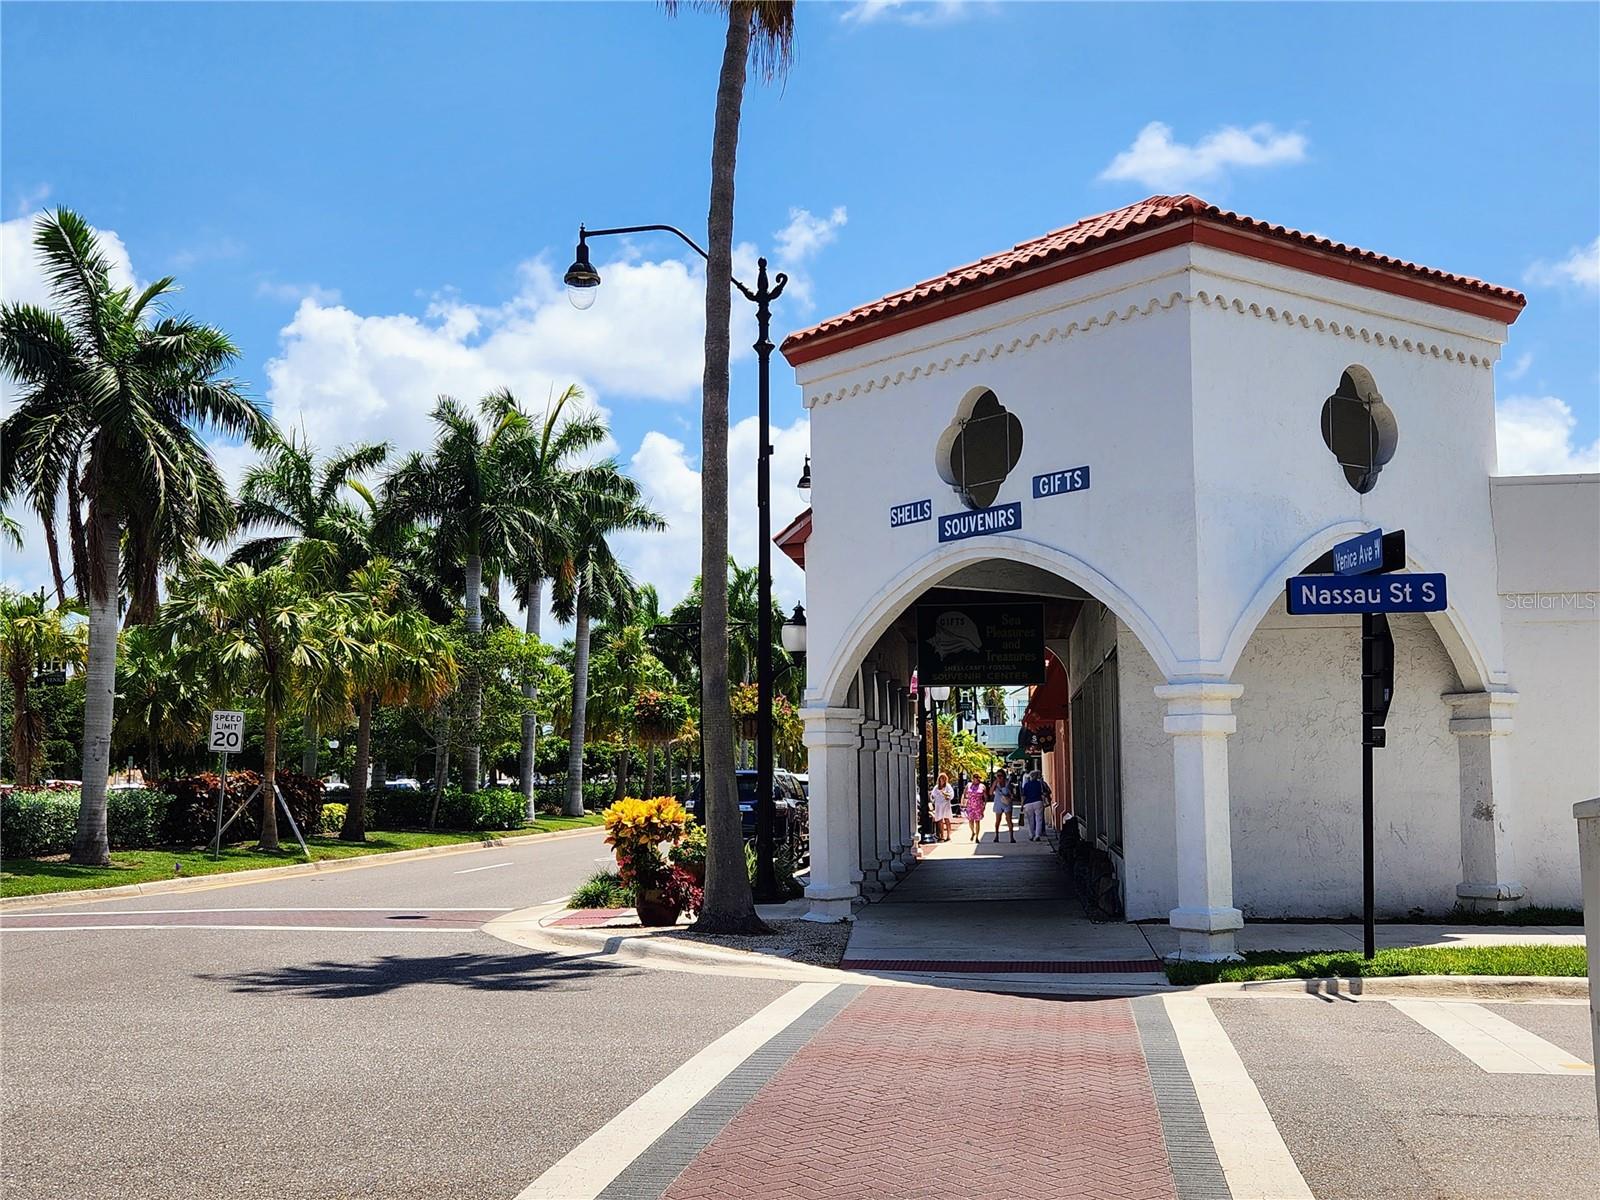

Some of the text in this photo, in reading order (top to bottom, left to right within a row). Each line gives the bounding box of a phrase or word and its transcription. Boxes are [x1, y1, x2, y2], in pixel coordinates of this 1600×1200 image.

[1039, 470, 1082, 495] GIFTS
[891, 502, 931, 525] SHELLS
[944, 508, 1015, 537] SOUVENIRS
[1335, 548, 1357, 572] Venice
[1358, 544, 1373, 565] Ave
[1301, 582, 1436, 605] Nassau St S
[940, 616, 966, 626] GIFTS
[1001, 614, 1021, 625] Sea
[1002, 639, 1021, 649] and
[985, 649, 1037, 662] Treasures
[932, 671, 1030, 681] SOUVENIR CENTER
[214, 713, 242, 723] SPEED
[216, 723, 238, 731] LIMIT
[213, 732, 240, 747] 20
